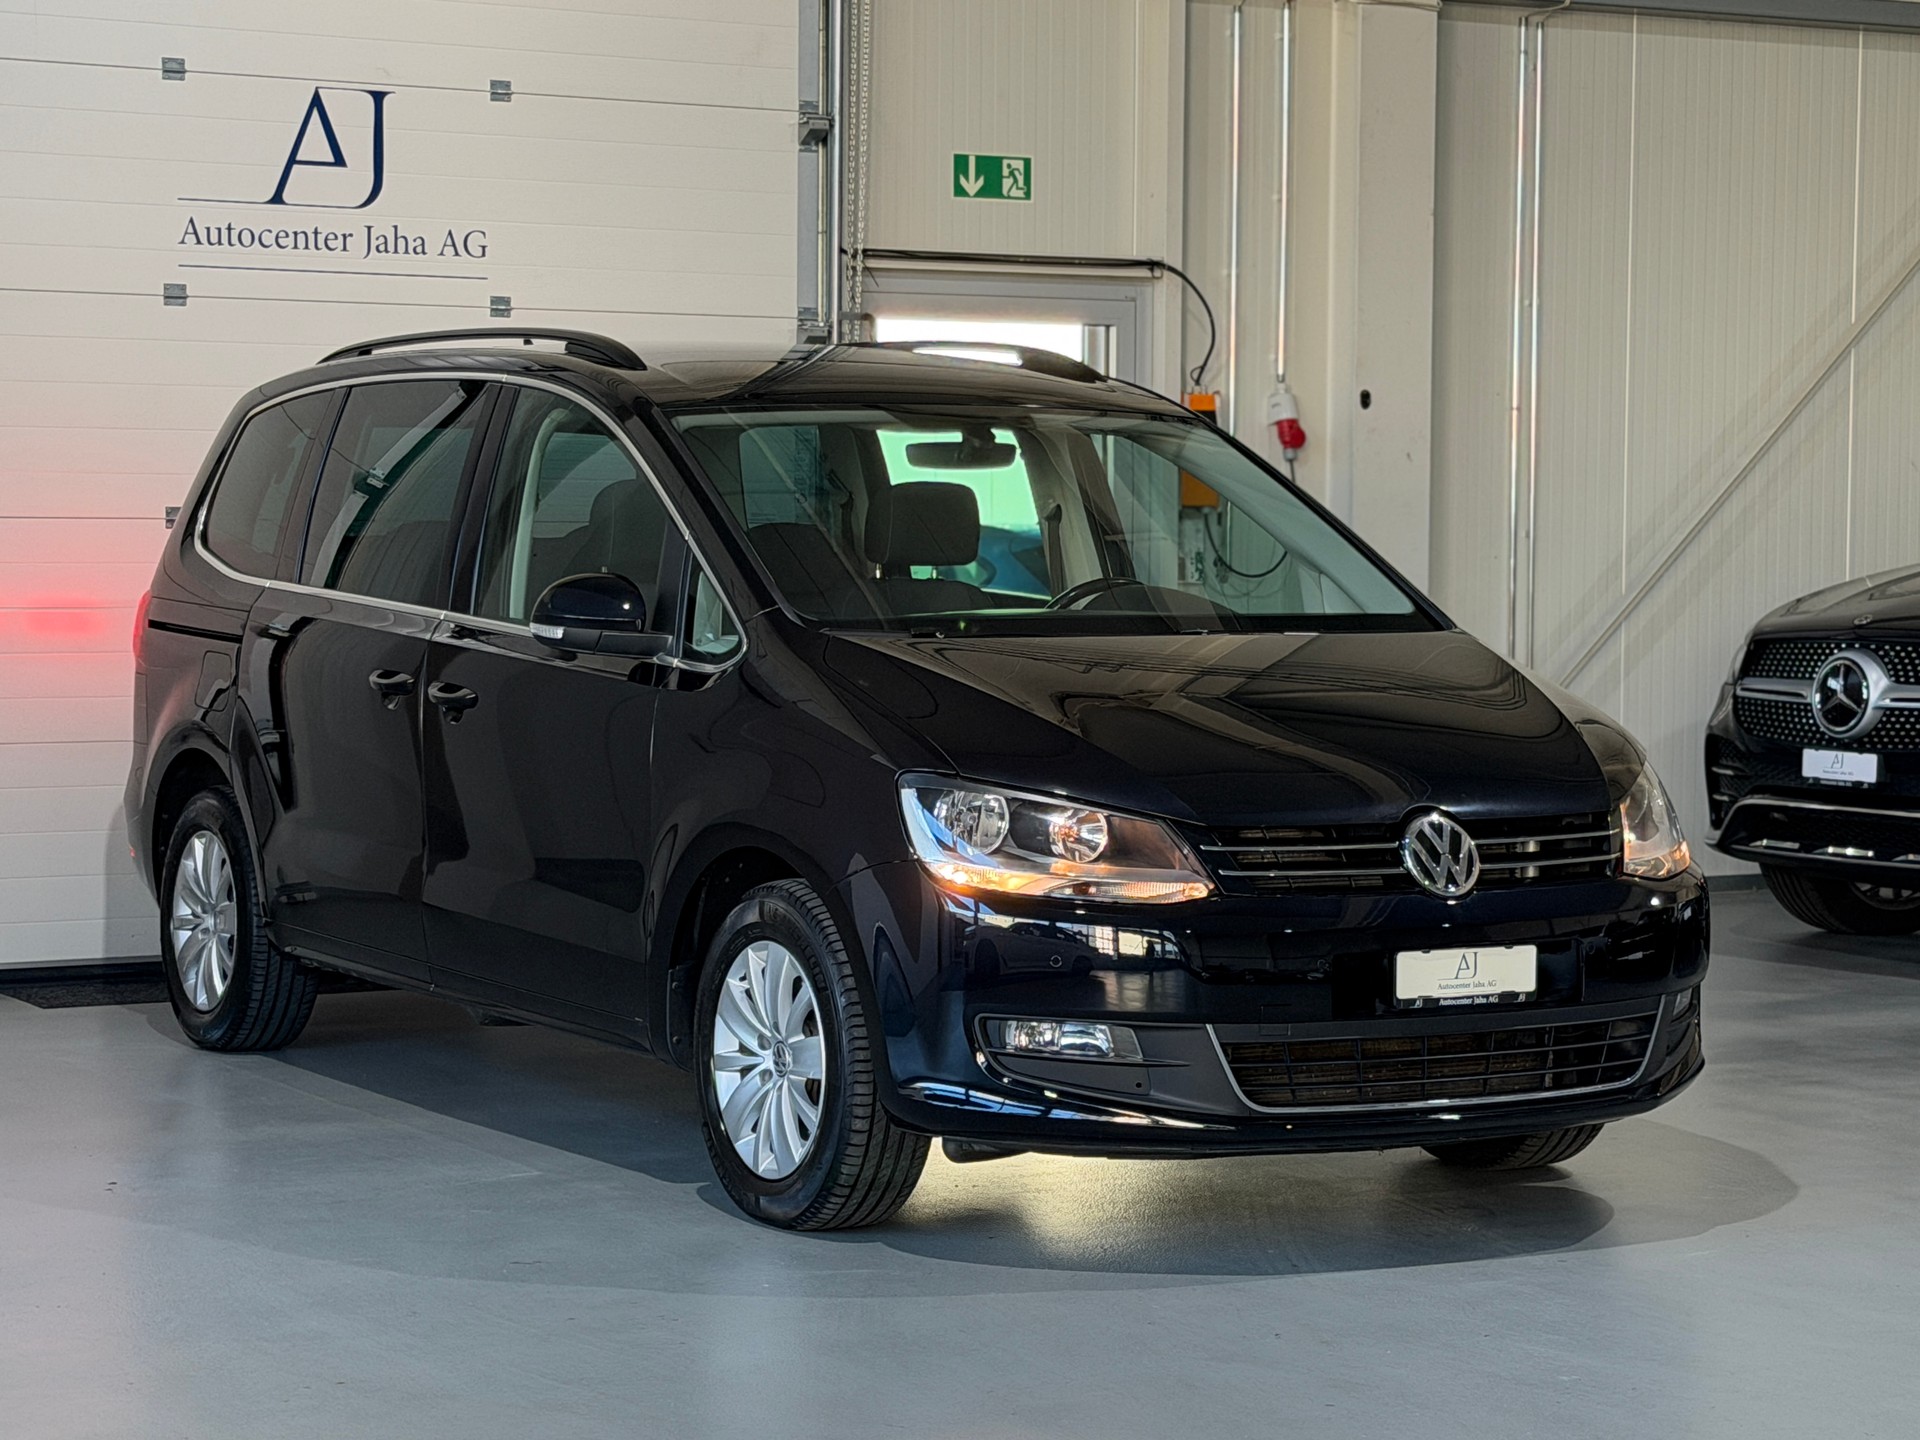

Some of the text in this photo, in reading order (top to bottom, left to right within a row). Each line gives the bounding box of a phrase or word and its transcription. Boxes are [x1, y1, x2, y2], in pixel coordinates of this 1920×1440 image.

[261, 86, 397, 210] AJ
[178, 215, 488, 260] Autocenter Jaha AG
[1453, 951, 1479, 980] AJ
[1437, 979, 1497, 990] Autocenter Jaha AG
[1438, 994, 1499, 1006] Autocenter Jaha AG
